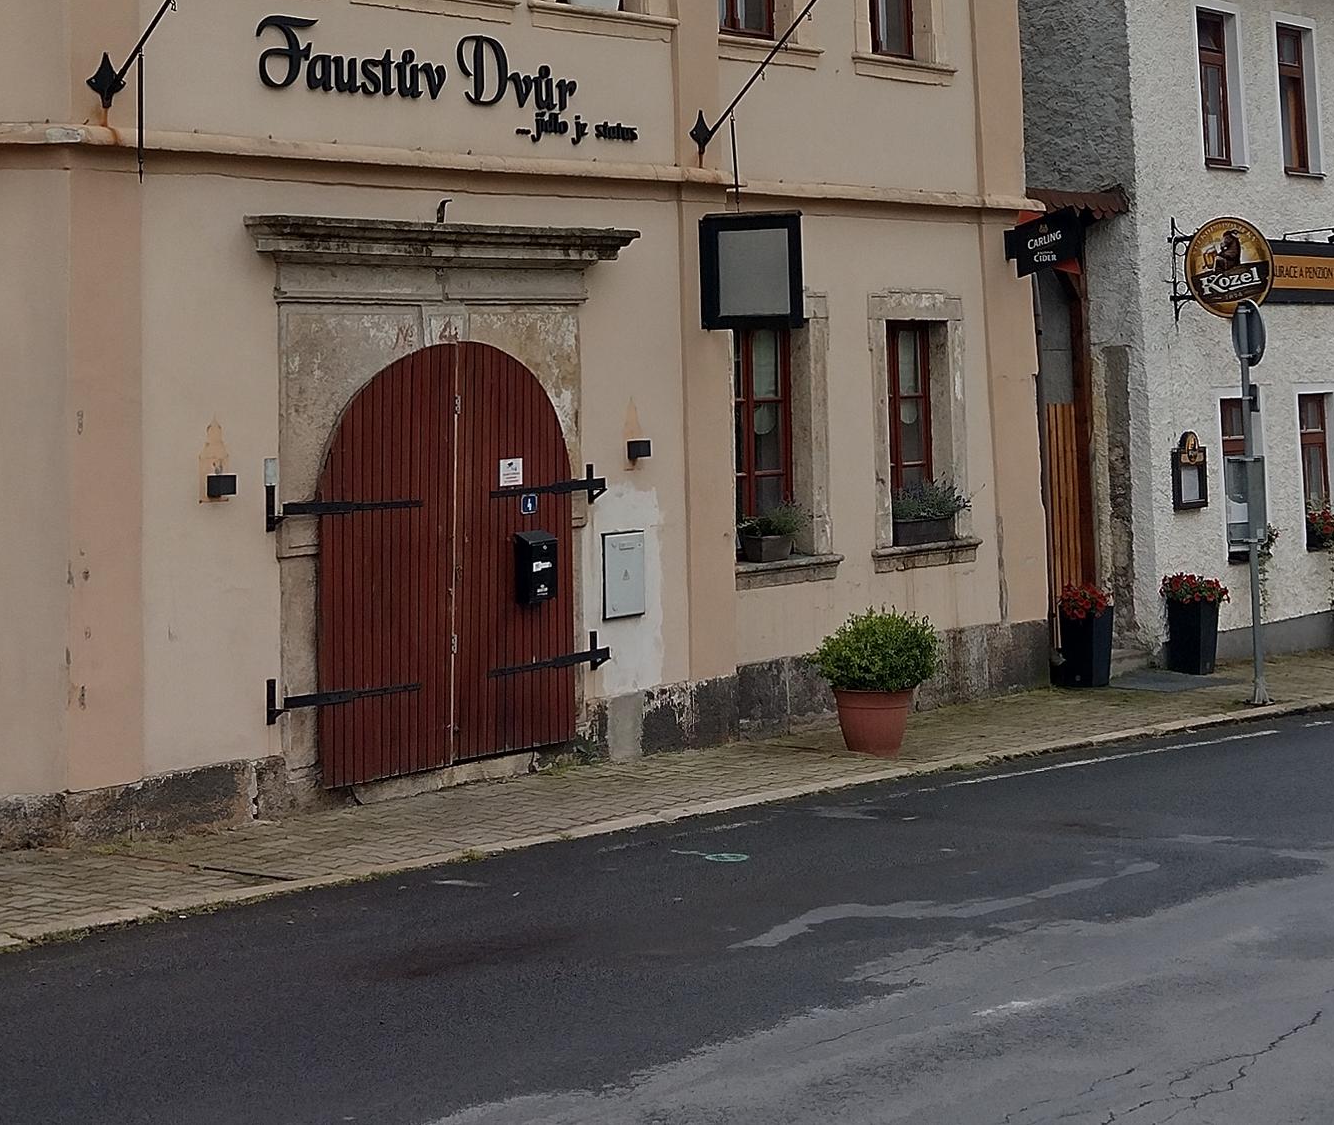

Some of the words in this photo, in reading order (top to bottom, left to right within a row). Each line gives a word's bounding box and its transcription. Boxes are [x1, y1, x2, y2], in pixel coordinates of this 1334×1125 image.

[255, 14, 447, 101] Faustův
[456, 34, 578, 112] Dvůr
[595, 121, 639, 142] status
[1027, 230, 1062, 250] CARLING
[1033, 254, 1058, 263] CIDER
[1200, 266, 1262, 296] Kozel
[1274, 265, 1298, 279] URACE
